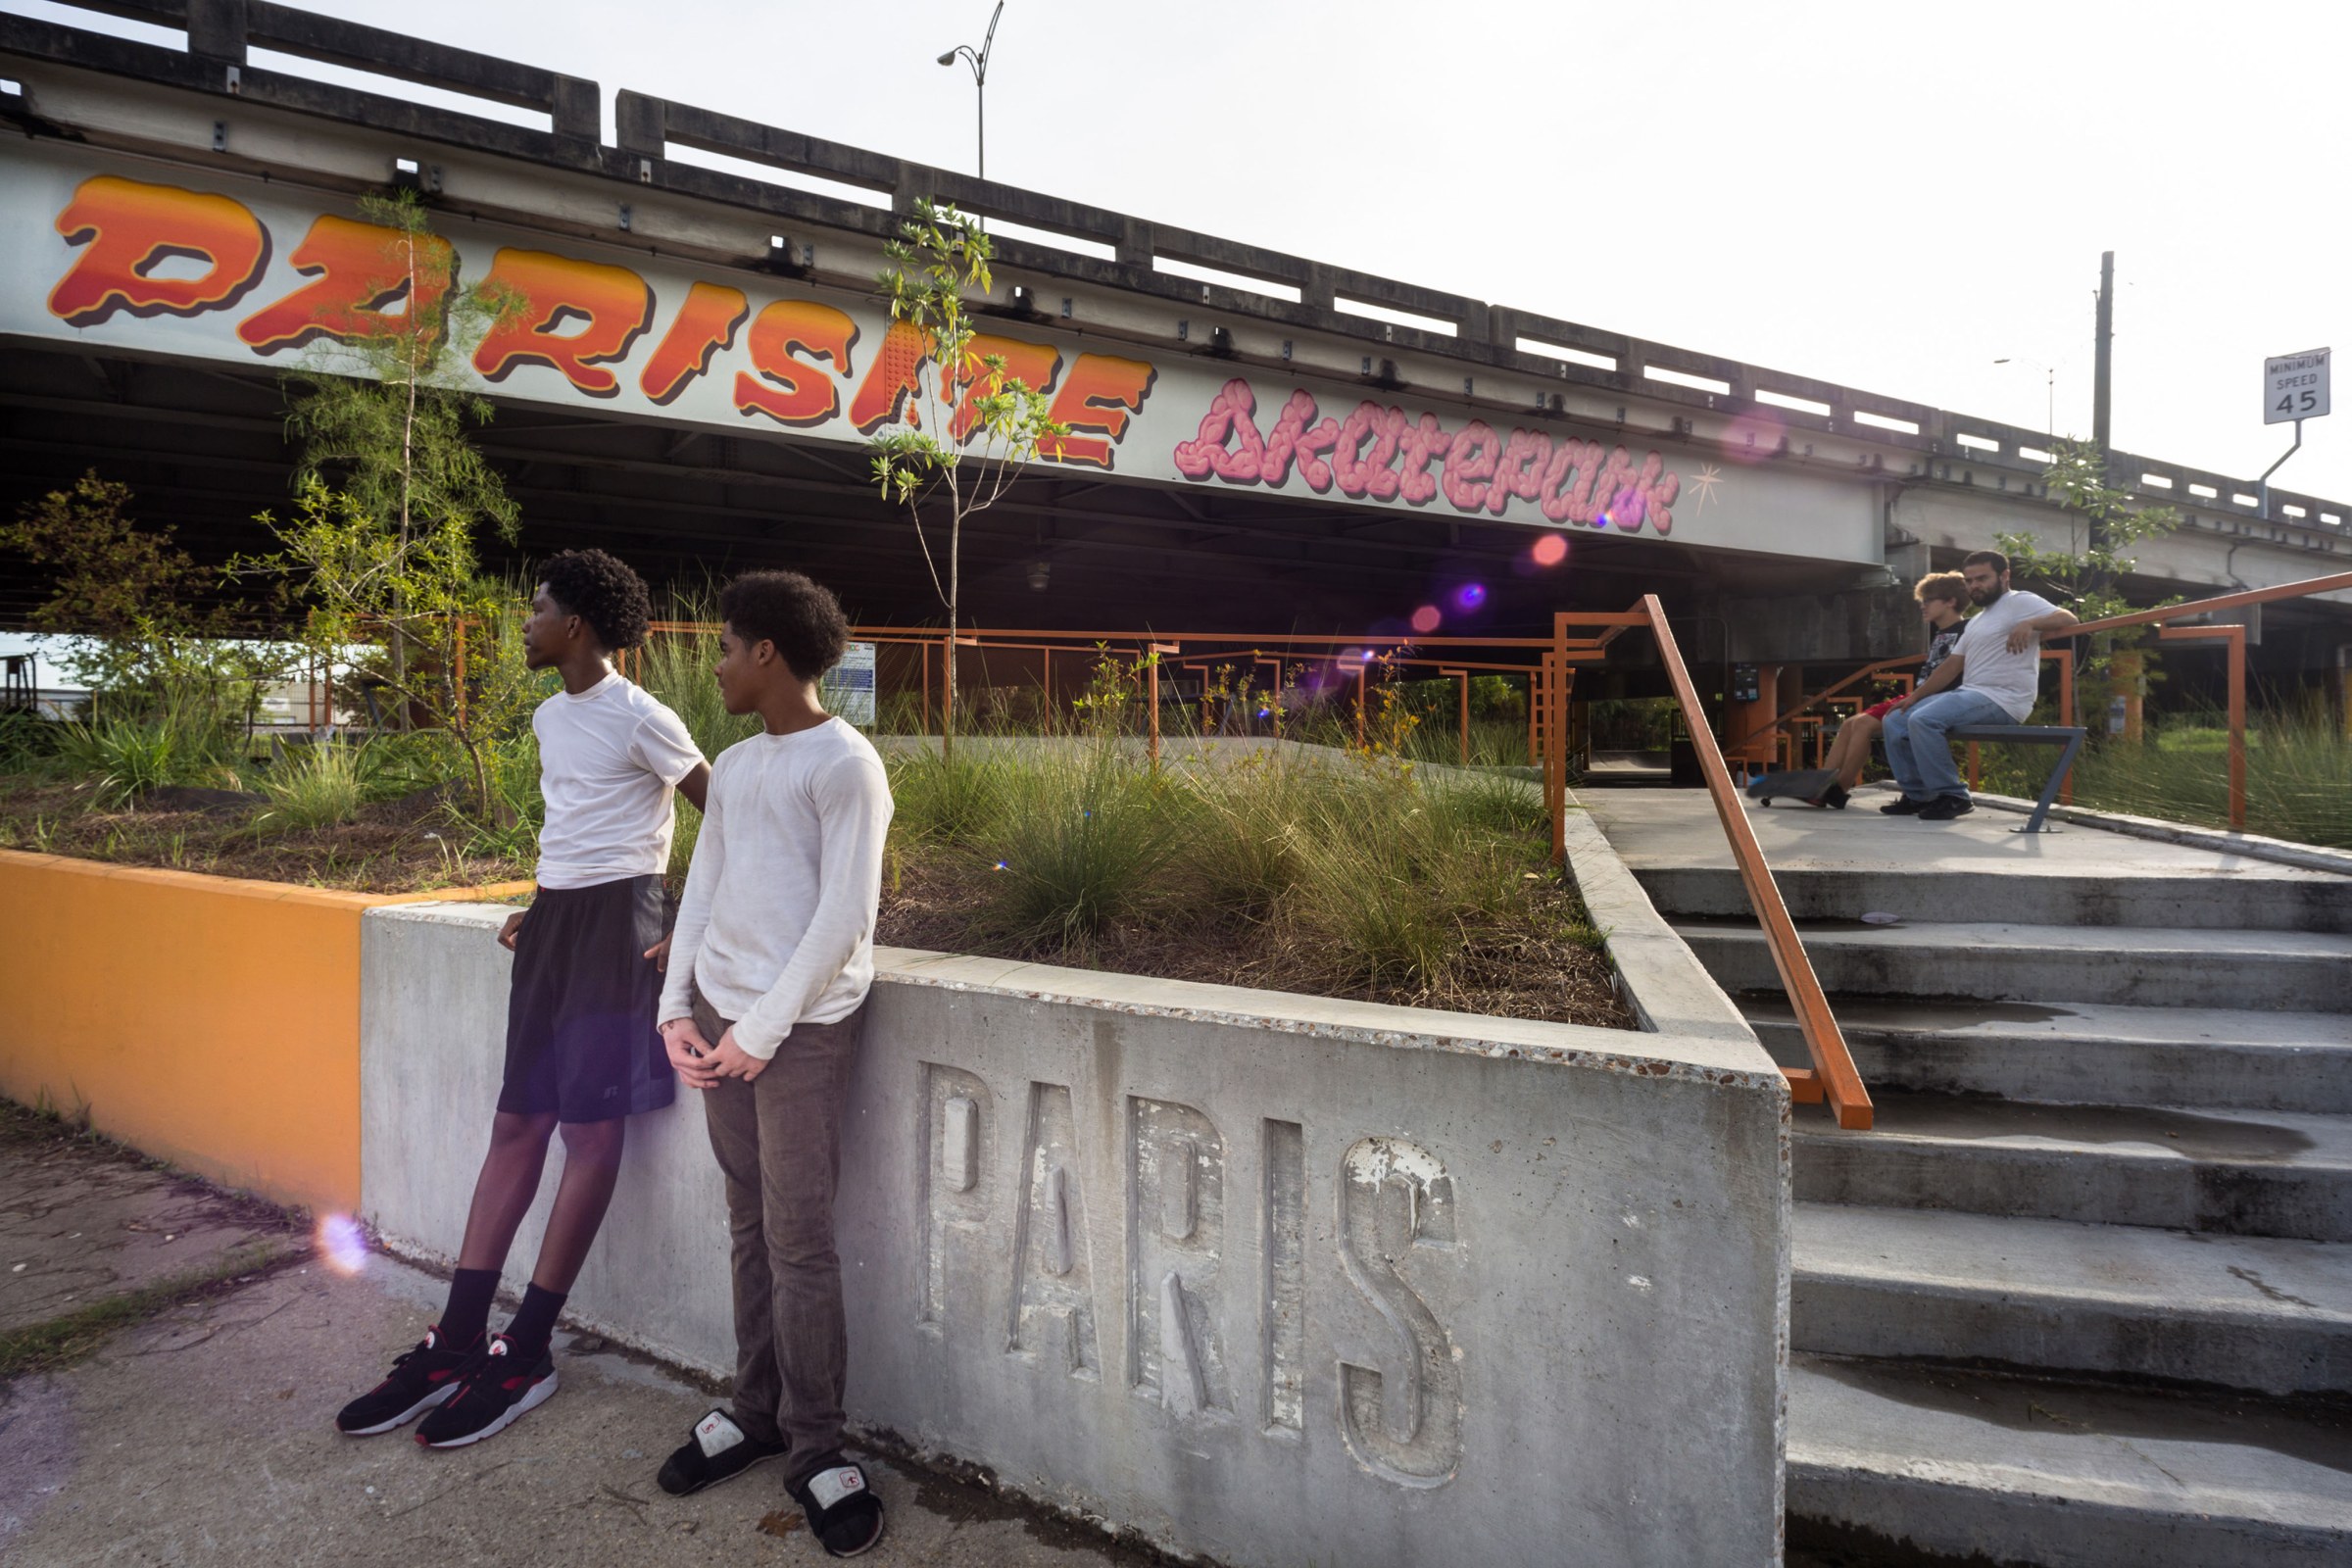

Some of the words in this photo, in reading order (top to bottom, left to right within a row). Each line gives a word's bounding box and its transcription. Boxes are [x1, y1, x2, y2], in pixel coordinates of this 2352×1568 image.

[47, 173, 1159, 473] PARISITE
[2270, 355, 2325, 374] MINIMUM
[2276, 373, 2318, 390] SPEED
[2276, 390, 2318, 415] 45
[916, 1057, 1464, 1491] PARIS
